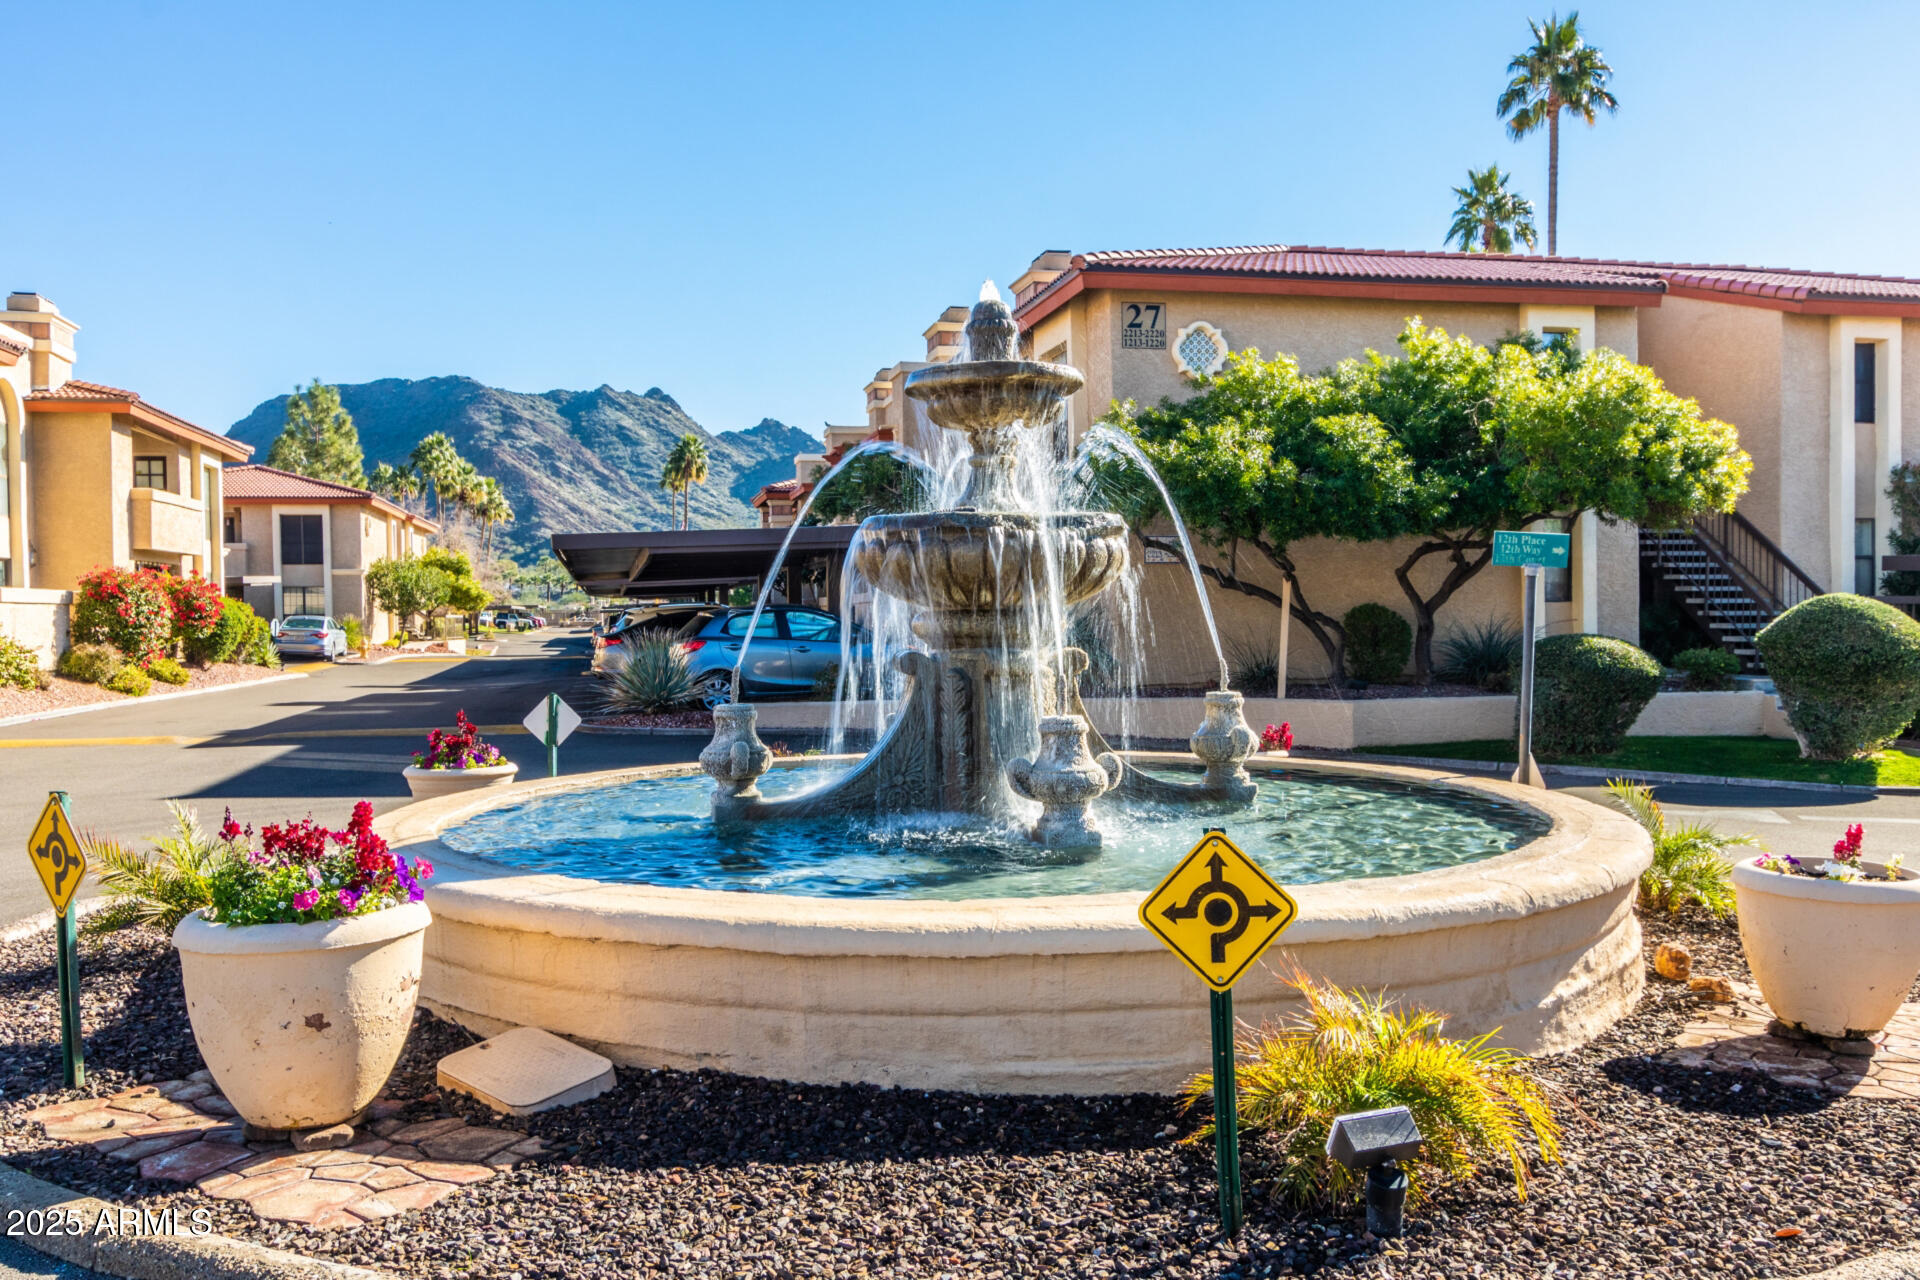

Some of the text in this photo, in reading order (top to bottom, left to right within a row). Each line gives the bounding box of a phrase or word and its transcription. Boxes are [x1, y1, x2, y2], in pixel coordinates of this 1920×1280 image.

[1126, 304, 1161, 329] 27
[1124, 329, 1165, 338] 2213-2220
[1124, 338, 1165, 348] 1213-1220
[1498, 534, 1547, 546] 12th Place
[1501, 544, 1542, 556] 12th Way
